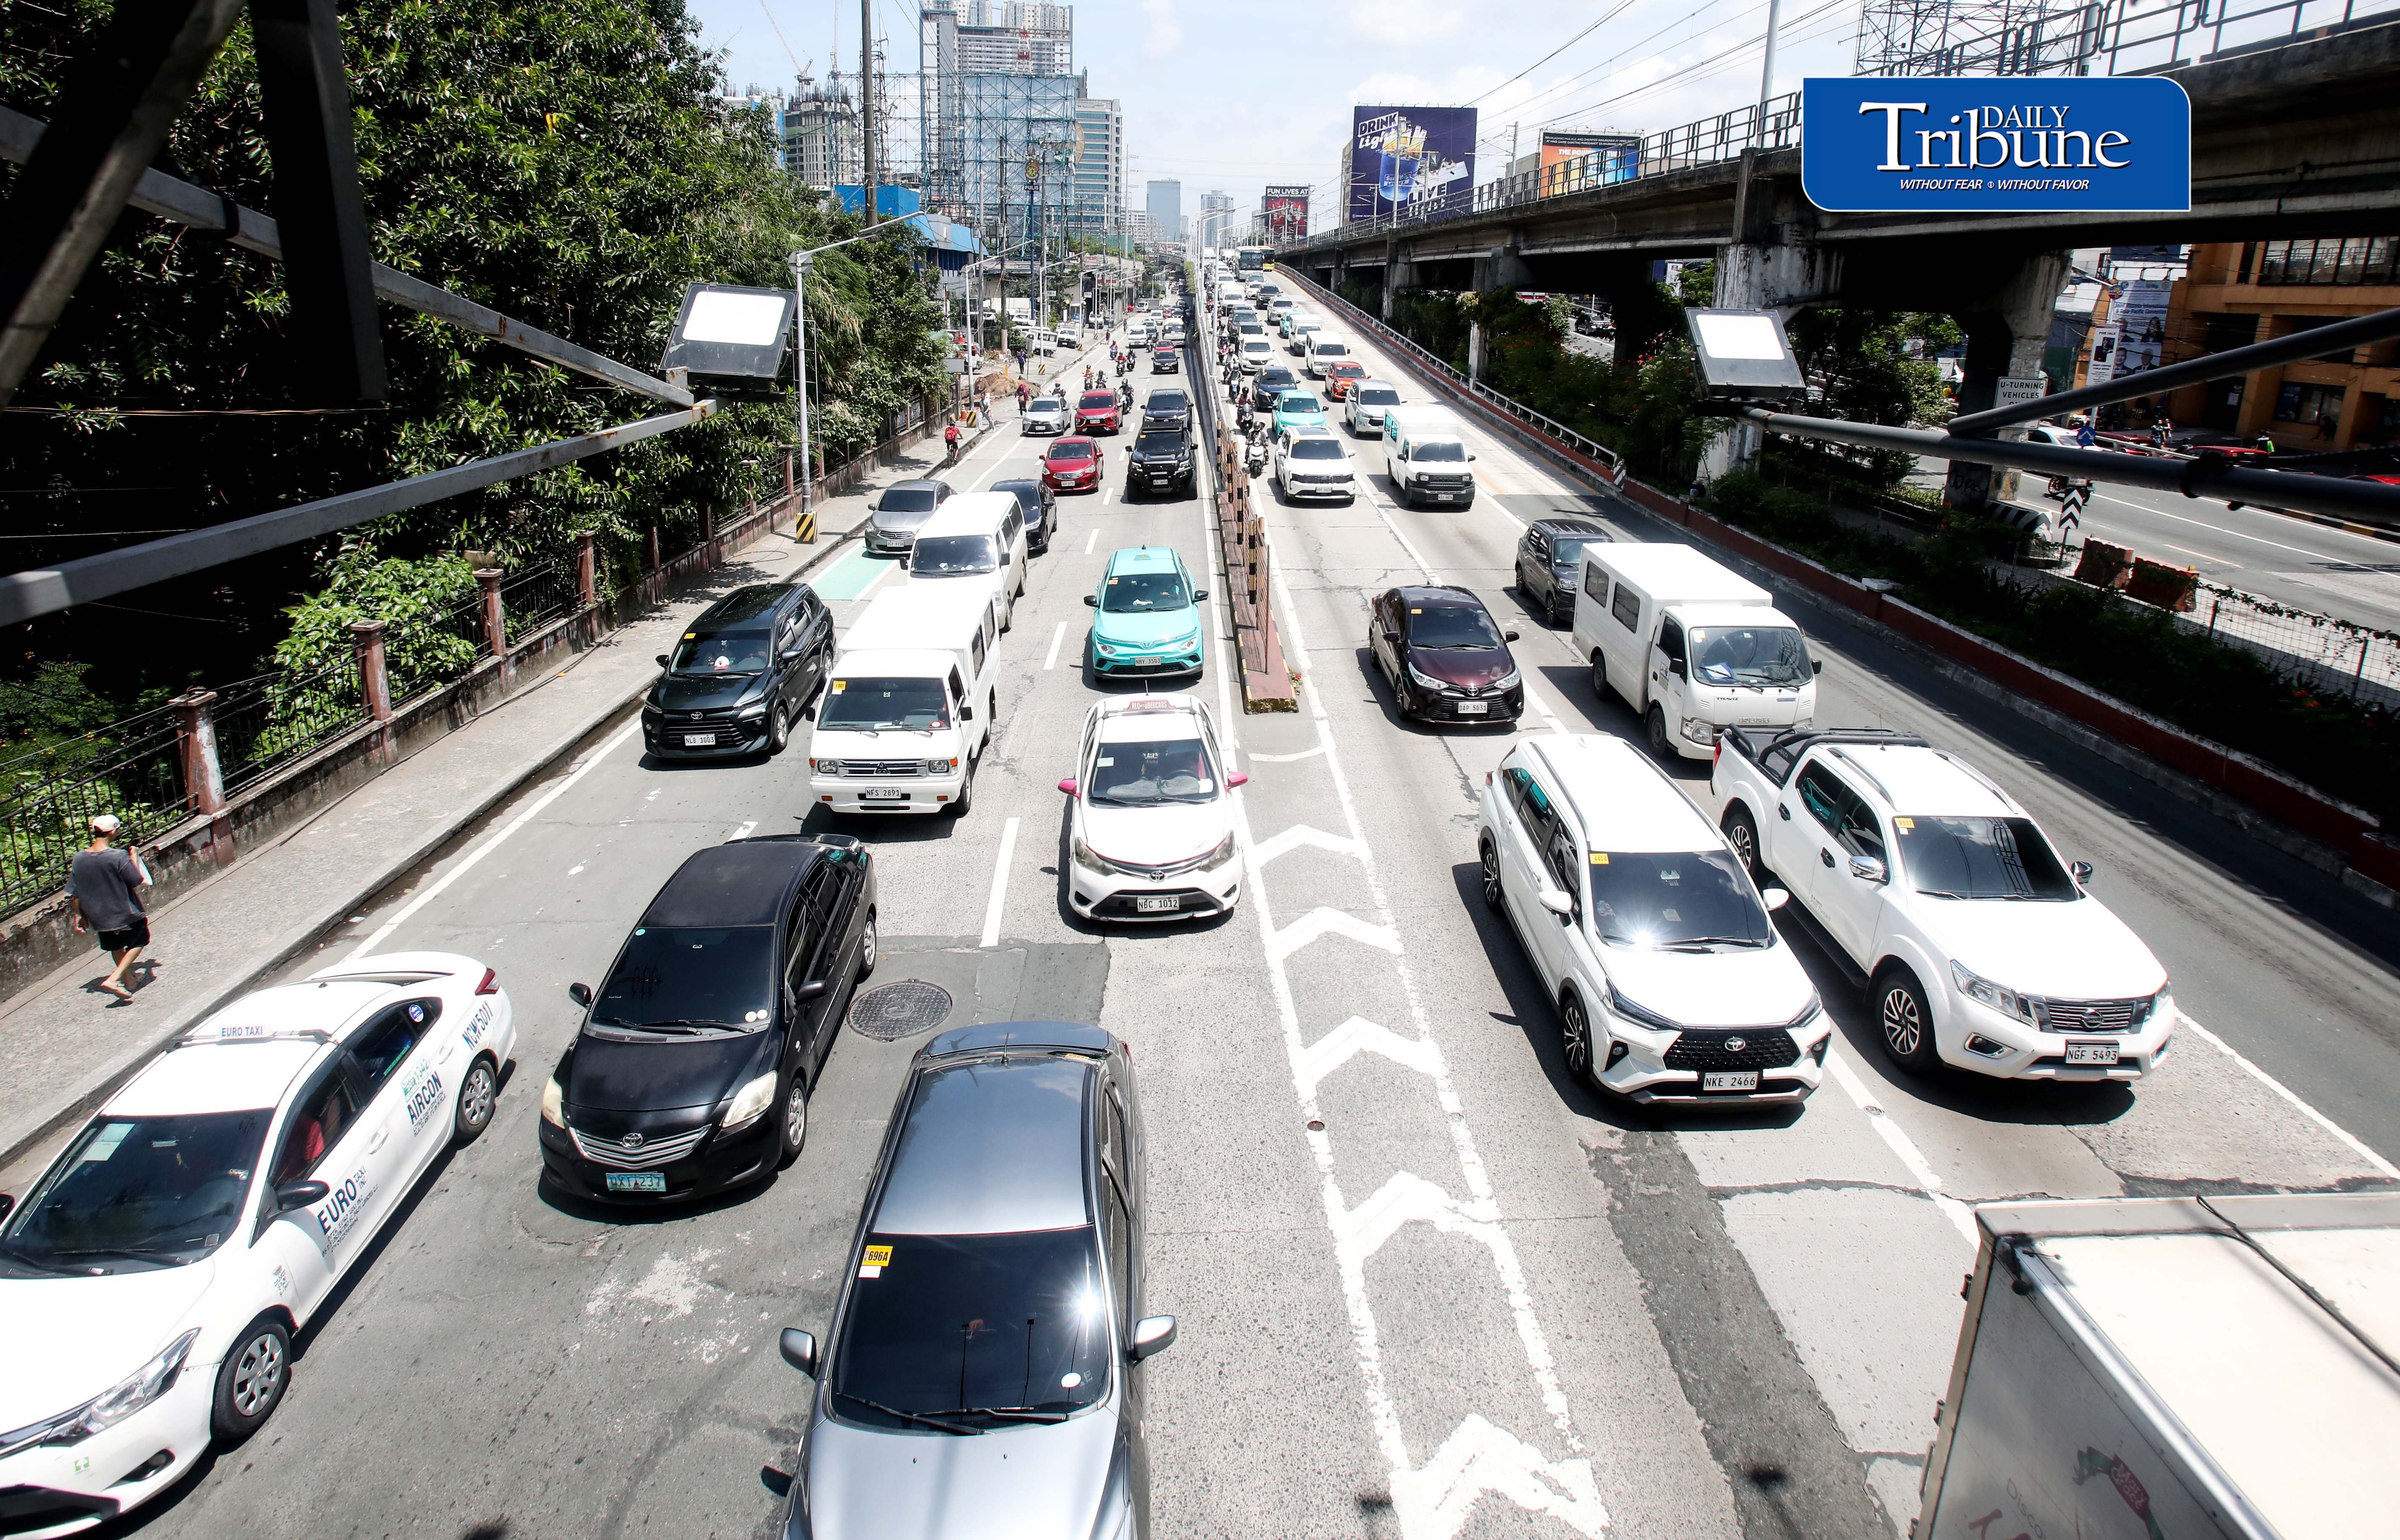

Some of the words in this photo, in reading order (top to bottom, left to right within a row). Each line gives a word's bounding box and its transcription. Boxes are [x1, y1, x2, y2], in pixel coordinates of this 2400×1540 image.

[1360, 114, 1397, 135] DRINK
[1409, 183, 1446, 205] LIVE
[1139, 900, 1153, 909] NBC
[221, 1027, 243, 1037] EURO
[245, 1026, 263, 1035] TAXI
[2068, 1050, 2087, 1060] NGF
[2093, 1050, 2117, 1060] 5493
[1705, 1077, 1724, 1087] NKE
[1730, 1077, 1755, 1086] 2466
[407, 1071, 442, 1125] AIRCON
[353, 1165, 367, 1183] TAXI
[639, 1176, 660, 1187] 237
[317, 1178, 357, 1235] EURO
[868, 1251, 889, 1262] 696A
[2006, 1478, 2046, 1540] Disco
